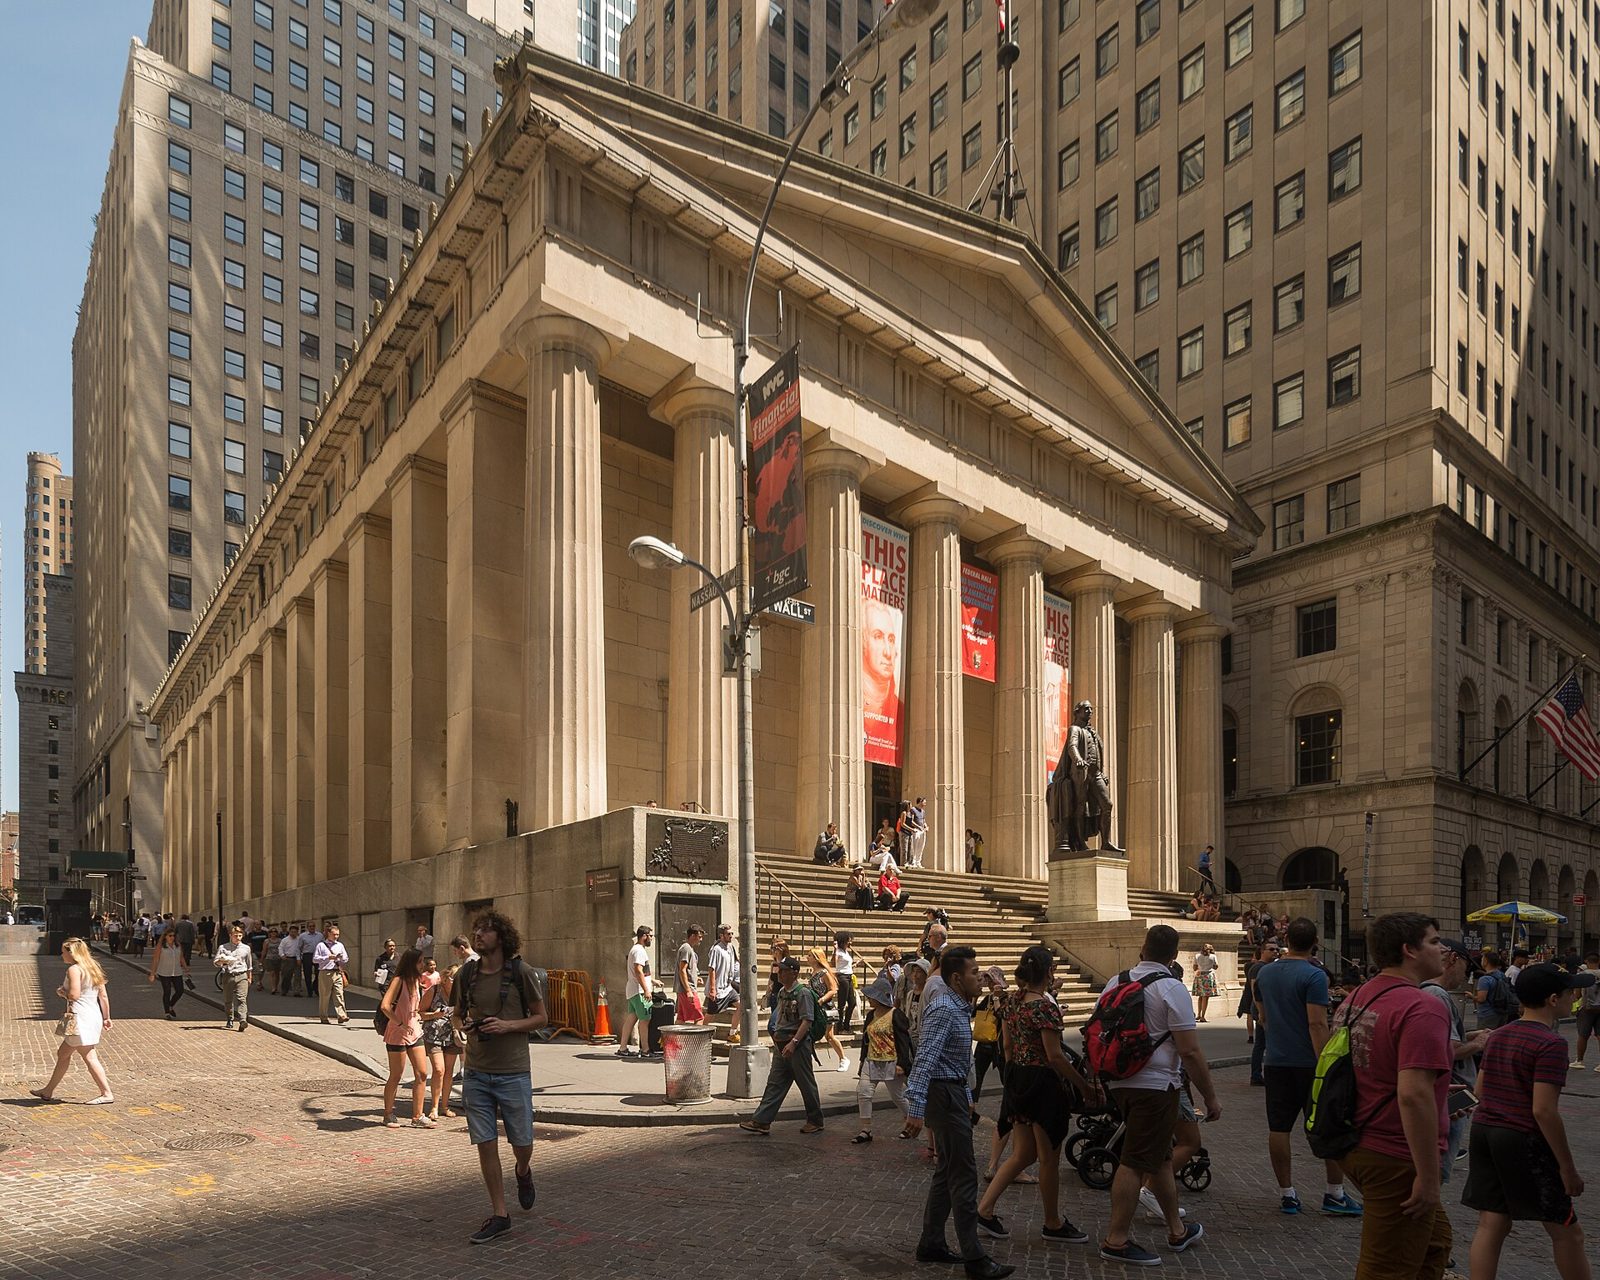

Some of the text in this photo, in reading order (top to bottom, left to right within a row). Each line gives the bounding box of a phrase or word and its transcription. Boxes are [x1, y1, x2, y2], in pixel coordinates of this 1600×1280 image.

[763, 369, 785, 400] NYC
[753, 384, 799, 440] financial
[862, 518, 908, 542] DISCOVER WHY
[863, 531, 906, 574] THIS
[773, 566, 791, 585] bgc
[861, 560, 906, 596] PLACE
[691, 586, 717, 609] NASSAU
[773, 600, 812, 619] WALL ST
[861, 583, 905, 611] MATTERS
[1044, 606, 1069, 637] HIS
[1045, 630, 1069, 656] LACE
[1044, 650, 1069, 669] ATTERS
